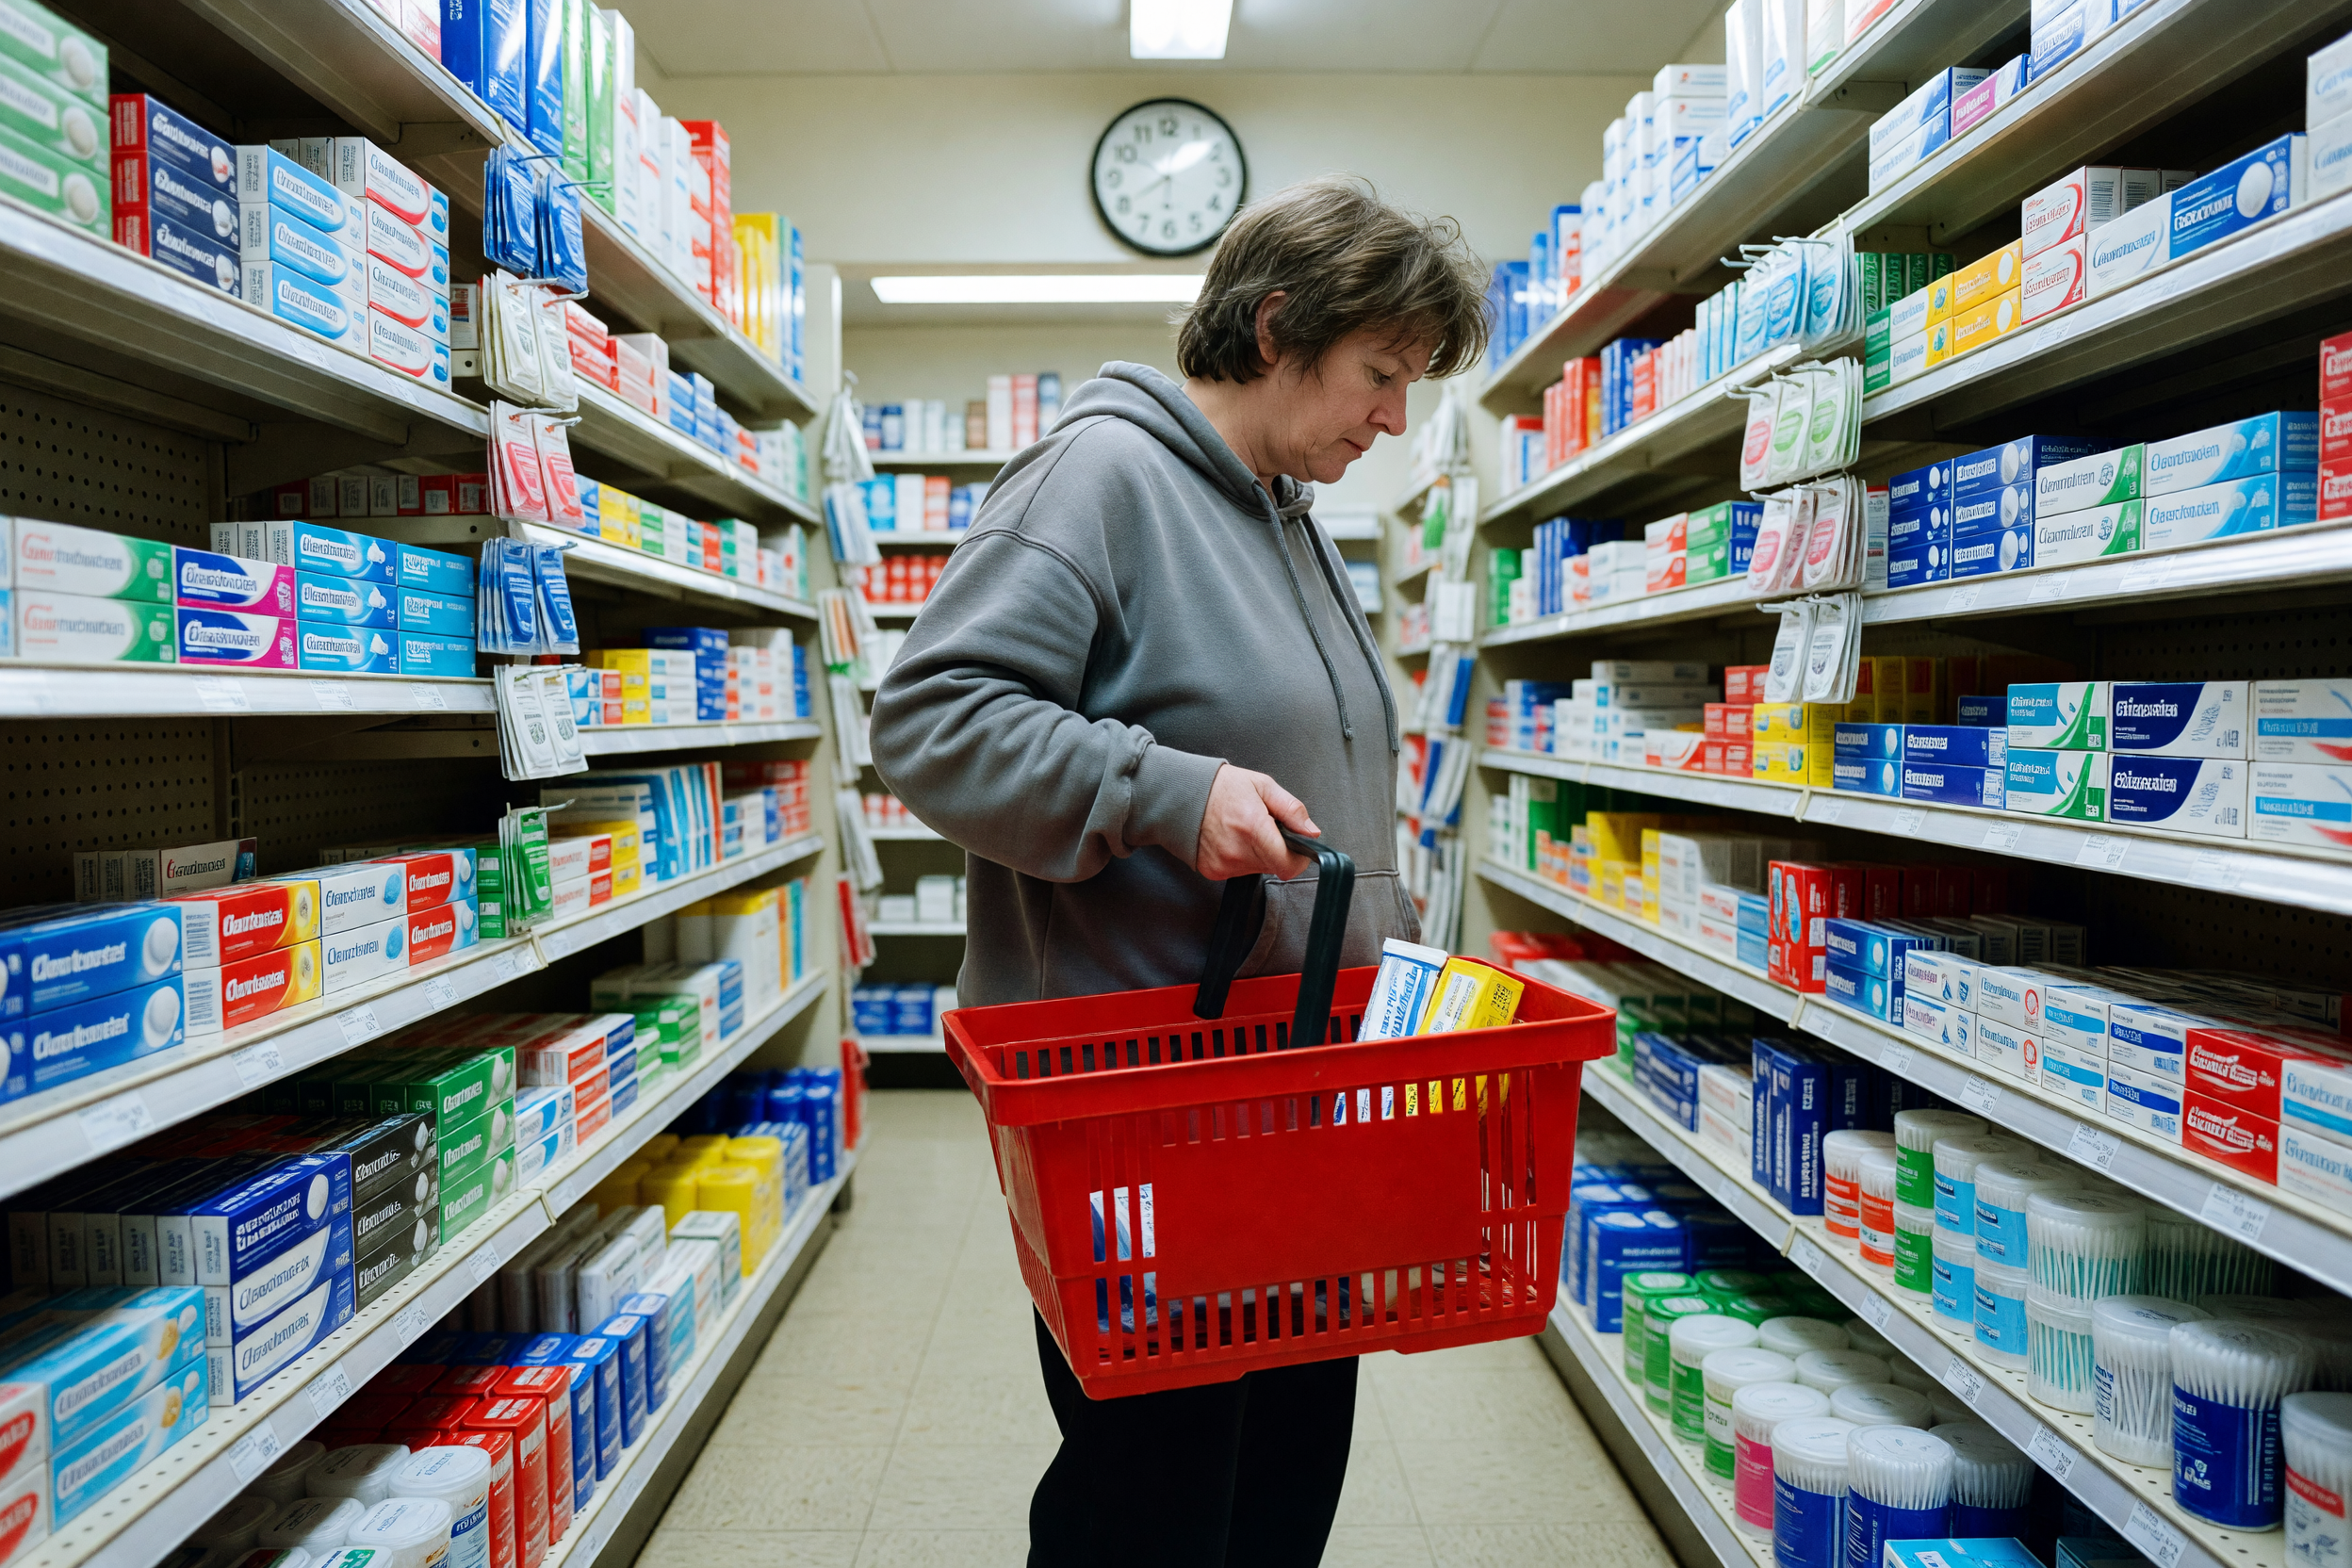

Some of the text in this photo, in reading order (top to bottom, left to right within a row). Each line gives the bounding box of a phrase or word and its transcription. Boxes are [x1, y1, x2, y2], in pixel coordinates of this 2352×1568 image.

[1134, 124, 1152, 143] 11
[1158, 116, 1179, 138] 12
[1114, 143, 1138, 164] 10
[1117, 195, 1130, 215] 8
[1206, 194, 1222, 212] 4
[1137, 212, 1151, 235] 7
[1161, 219, 1177, 239] 6
